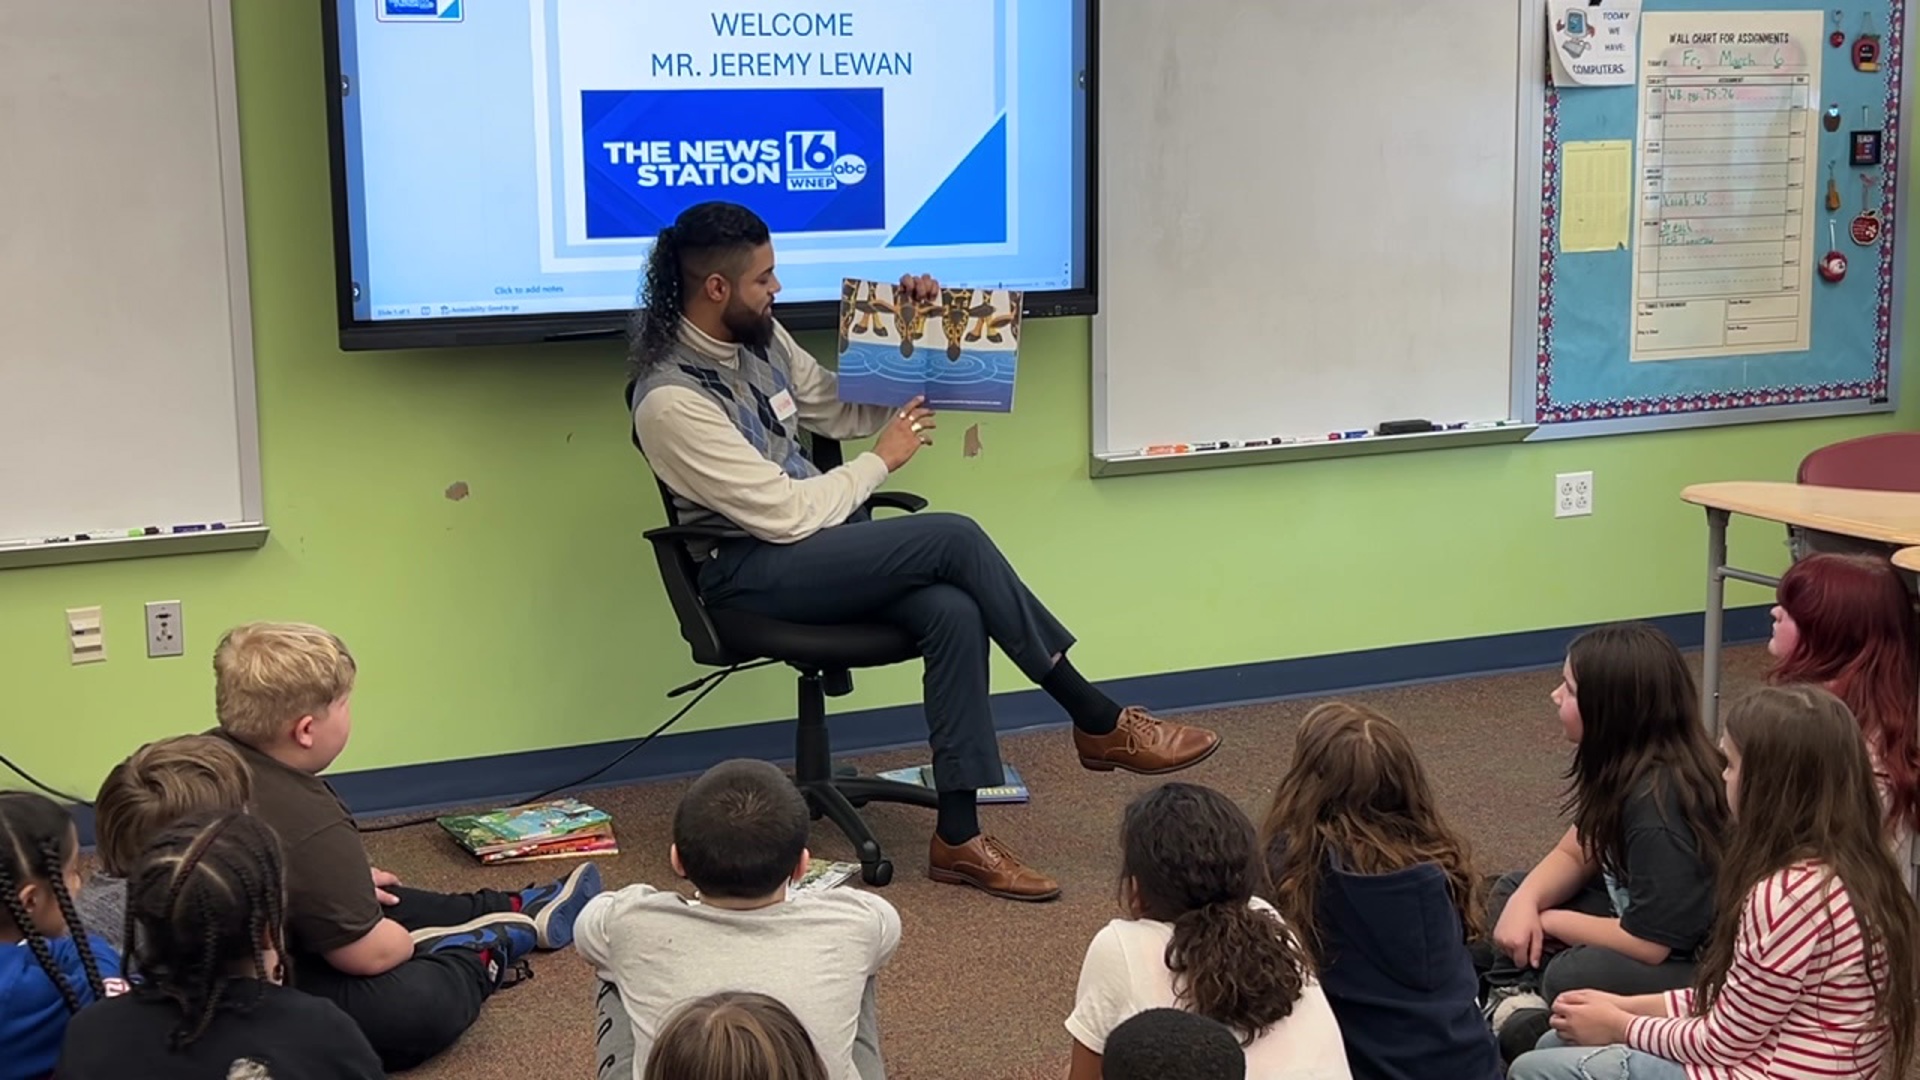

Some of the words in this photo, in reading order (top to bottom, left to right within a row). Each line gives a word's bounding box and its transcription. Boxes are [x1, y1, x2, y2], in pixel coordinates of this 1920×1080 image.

[1603, 12, 1630, 20] TODAY
[711, 12, 854, 37] WELCOME
[1608, 27, 1620, 35] WE
[1669, 34, 1689, 44] WALL
[1692, 33, 1717, 43] CHART
[1719, 33, 1734, 43] FOR
[1737, 32, 1789, 44] ASSIGNMENTS
[651, 53, 702, 77] MR.
[709, 52, 812, 77] JEREMY
[819, 52, 912, 76] LEWAN
[1773, 48, 1784, 66] 6
[603, 141, 671, 164] THE
[680, 139, 781, 163] NEWS
[788, 134, 835, 170] 16
[637, 162, 781, 187] STATION
[834, 161, 866, 176] abc
[790, 178, 835, 190] WNEP
[494, 286, 513, 295] Click
[542, 285, 564, 293] notes
